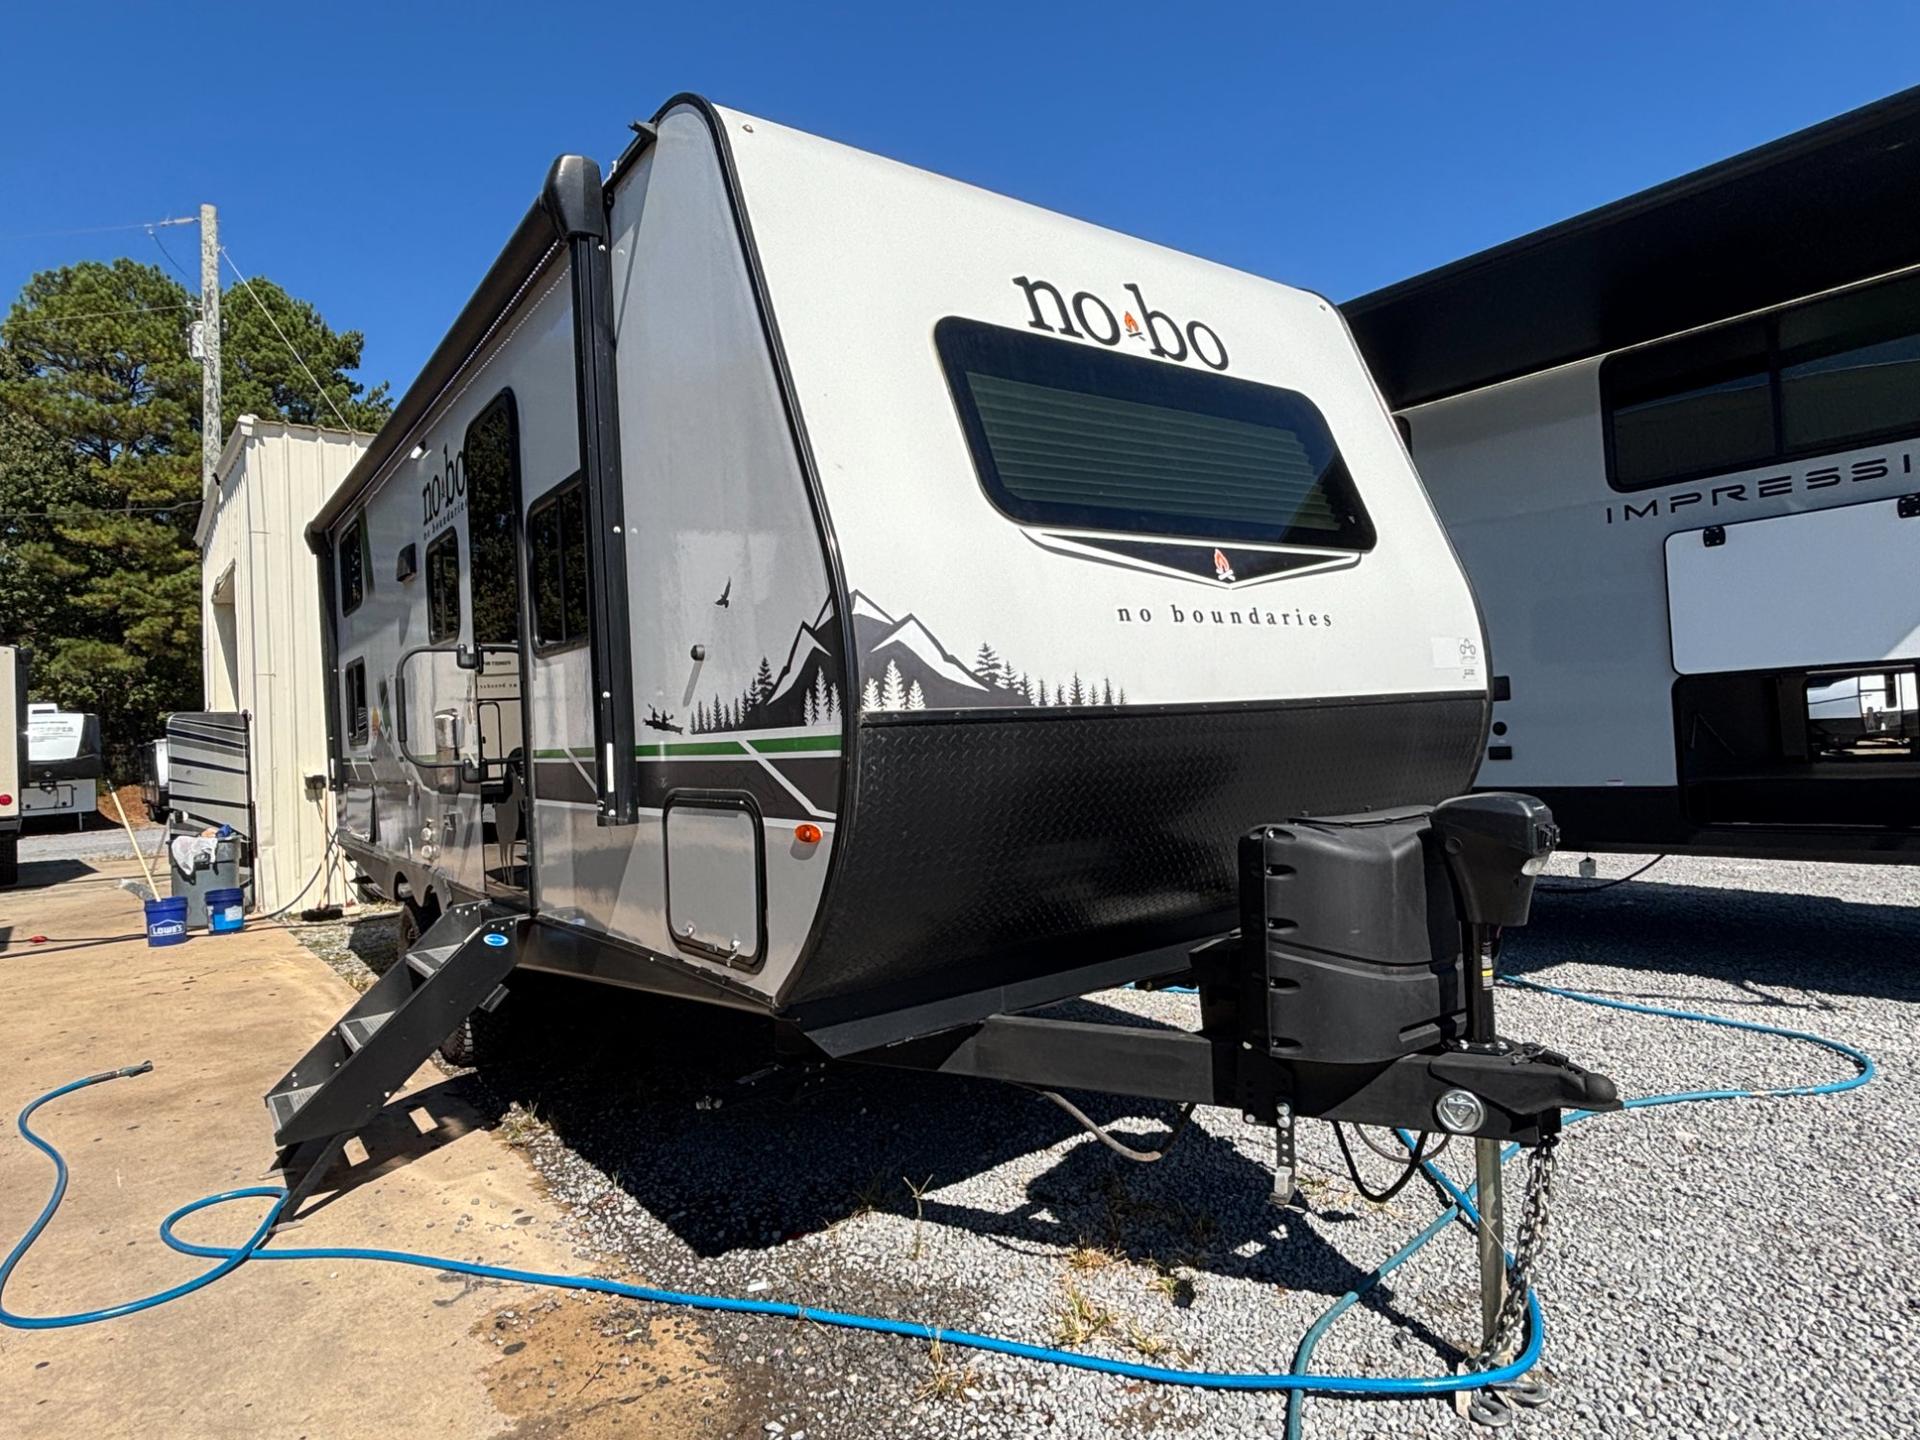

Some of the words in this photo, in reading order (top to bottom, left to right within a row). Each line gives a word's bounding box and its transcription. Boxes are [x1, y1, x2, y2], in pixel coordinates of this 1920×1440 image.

[1606, 454, 1911, 524] IMPRESSI
[1117, 607, 1152, 622] no
[1170, 604, 1332, 627] boundaries
[152, 924, 182, 935] LOWE'S
